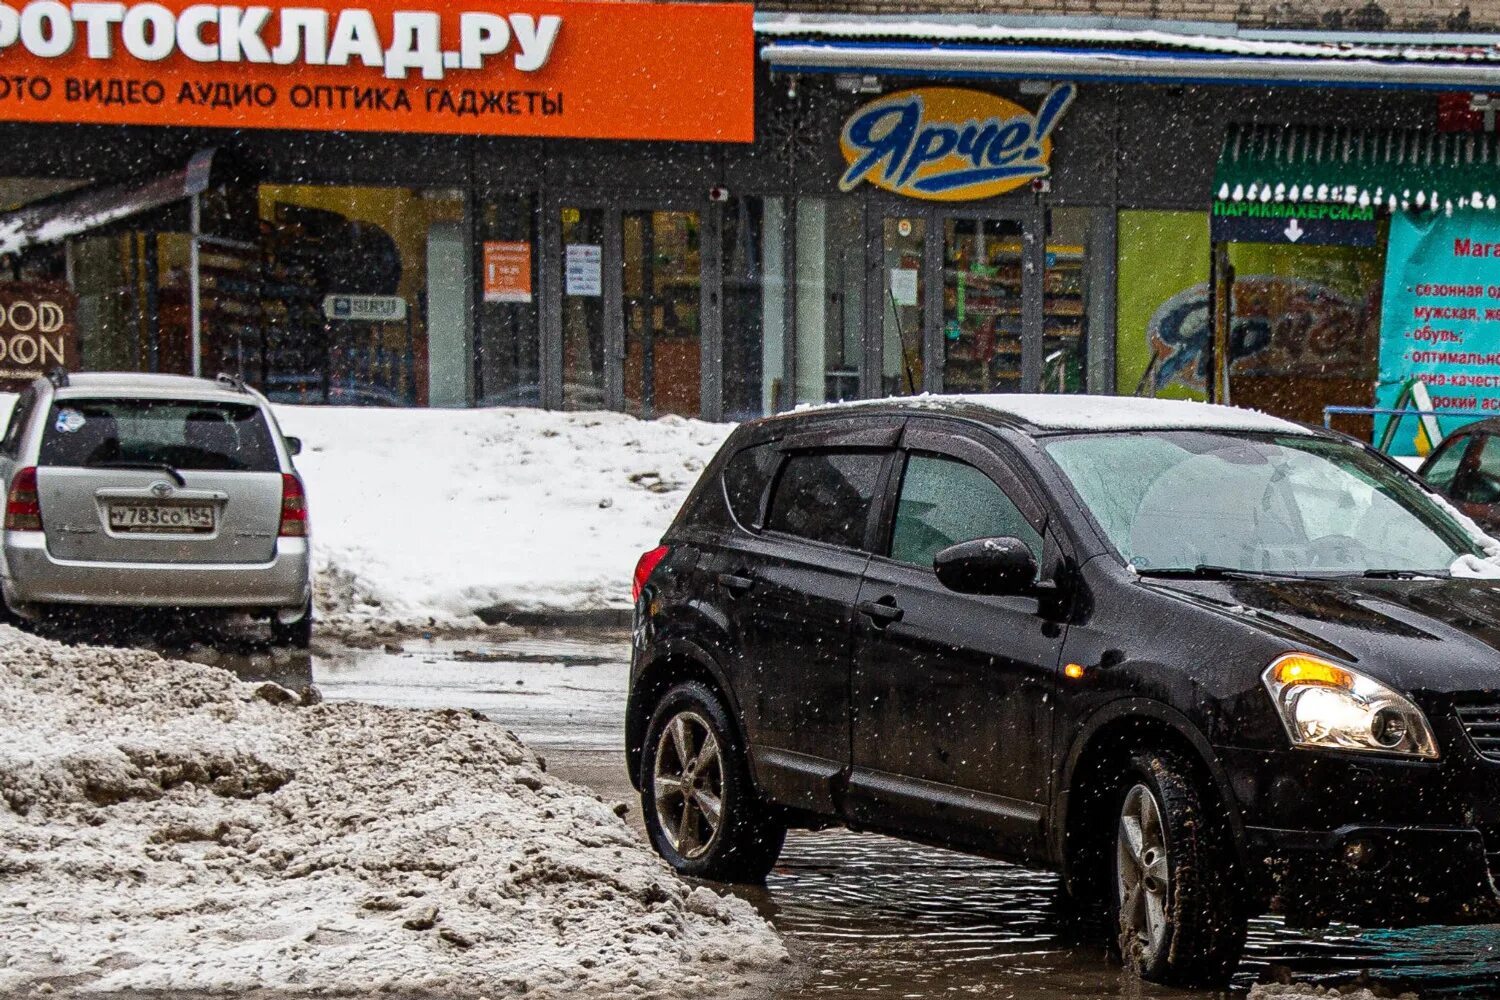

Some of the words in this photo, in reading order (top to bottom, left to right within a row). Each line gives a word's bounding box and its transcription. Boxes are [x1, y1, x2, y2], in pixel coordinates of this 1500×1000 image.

[64, 78, 165, 106] ВИДЕО
[178, 81, 277, 110] АУДИО
[289, 85, 412, 112] ОПТИКА
[425, 88, 564, 117] ГАДЖЕТЫ
[840, 84, 1076, 188] Ярче!
[1214, 201, 1375, 221] ПАРИКМАХЕРСКАЯ
[1415, 283, 1484, 298] сезонная
[1414, 306, 1480, 322] мужская,
[1413, 325, 1464, 345] обувь;
